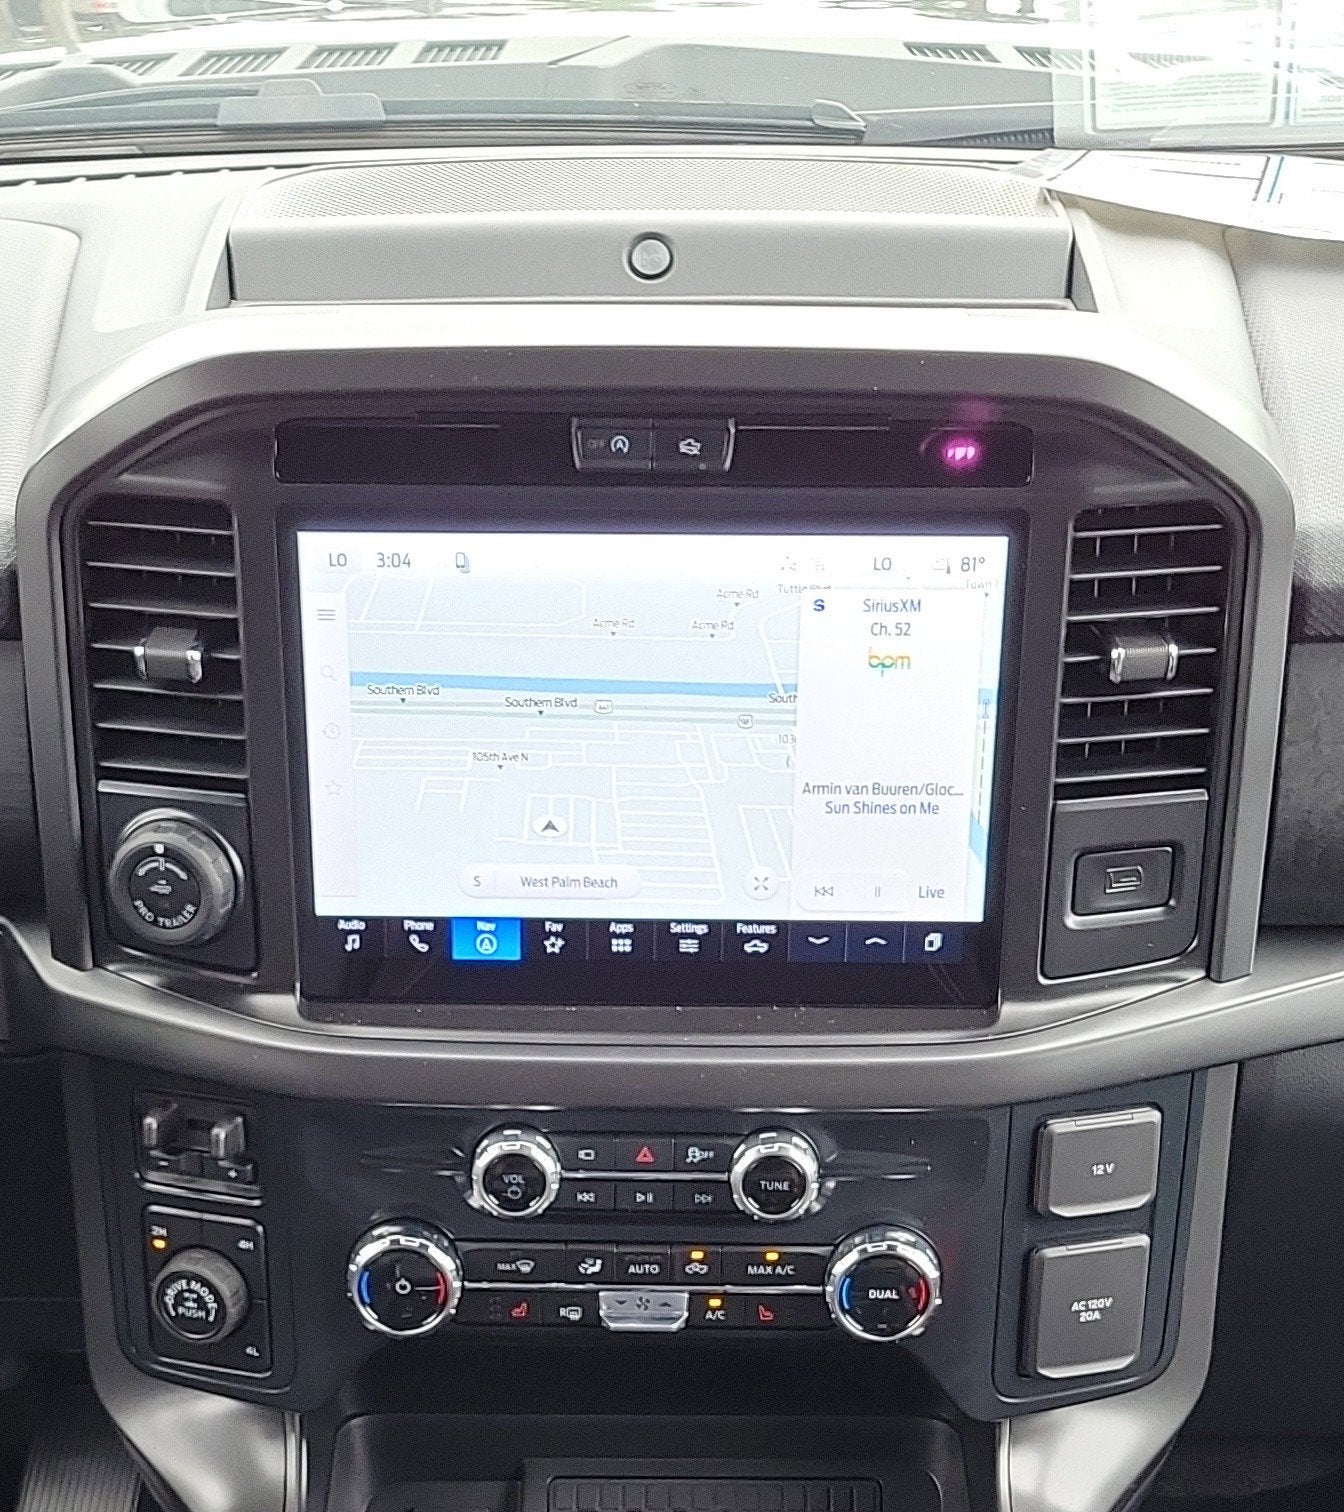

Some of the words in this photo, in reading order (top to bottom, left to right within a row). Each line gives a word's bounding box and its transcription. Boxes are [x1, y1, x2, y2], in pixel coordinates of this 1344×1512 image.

[329, 553, 348, 567] LO
[376, 552, 411, 568] 3:04
[873, 558, 892, 571] LO
[961, 556, 986, 573] 81°
[745, 589, 759, 599] Rd
[863, 599, 922, 613] SiriusXM
[593, 618, 617, 629] Acme
[619, 618, 635, 629] Rd
[691, 621, 718, 631] Acme
[719, 621, 734, 631] Rd
[870, 622, 892, 636] Ch.
[894, 622, 912, 636] 52
[868, 650, 911, 677] bpm
[366, 684, 414, 696] Southern
[415, 684, 440, 696] Blvd
[505, 697, 552, 708] Southern
[553, 697, 578, 708] Blvd
[803, 783, 841, 797] Armin
[845, 785, 868, 797] van
[825, 801, 850, 815] Sun
[854, 801, 896, 815] Shines
[900, 804, 916, 815] on
[920, 802, 939, 815] Me
[473, 876, 481, 887] S
[520, 876, 548, 889] West
[551, 876, 581, 889] Palm
[583, 876, 618, 889] Beach
[918, 886, 945, 899] Live
[133, 900, 154, 922] PRO
[157, 903, 198, 928] TRAILER
[337, 919, 366, 931] Audio
[403, 919, 435, 932] Phone
[476, 920, 497, 932] Nav
[544, 921, 564, 933] Fav
[609, 921, 634, 935] Apps
[669, 923, 709, 936] Settings
[736, 923, 777, 935] Features
[502, 1174, 525, 1184] VOL
[760, 1180, 789, 1191] TUNE
[151, 1225, 168, 1237] 2H
[497, 1263, 516, 1271] MAX
[628, 1264, 660, 1274] AUTO
[747, 1265, 772, 1275] MAX
[774, 1265, 796, 1275] A/C
[163, 1279, 190, 1304] DRIVE
[190, 1280, 218, 1309] MODE
[869, 1289, 900, 1299] DUAL
[1071, 1300, 1087, 1312] AC
[1087, 1297, 1113, 1310] 120V
[177, 1306, 206, 1320] PUSH
[705, 1310, 725, 1320] A/C
[1080, 1311, 1101, 1322] 20A
